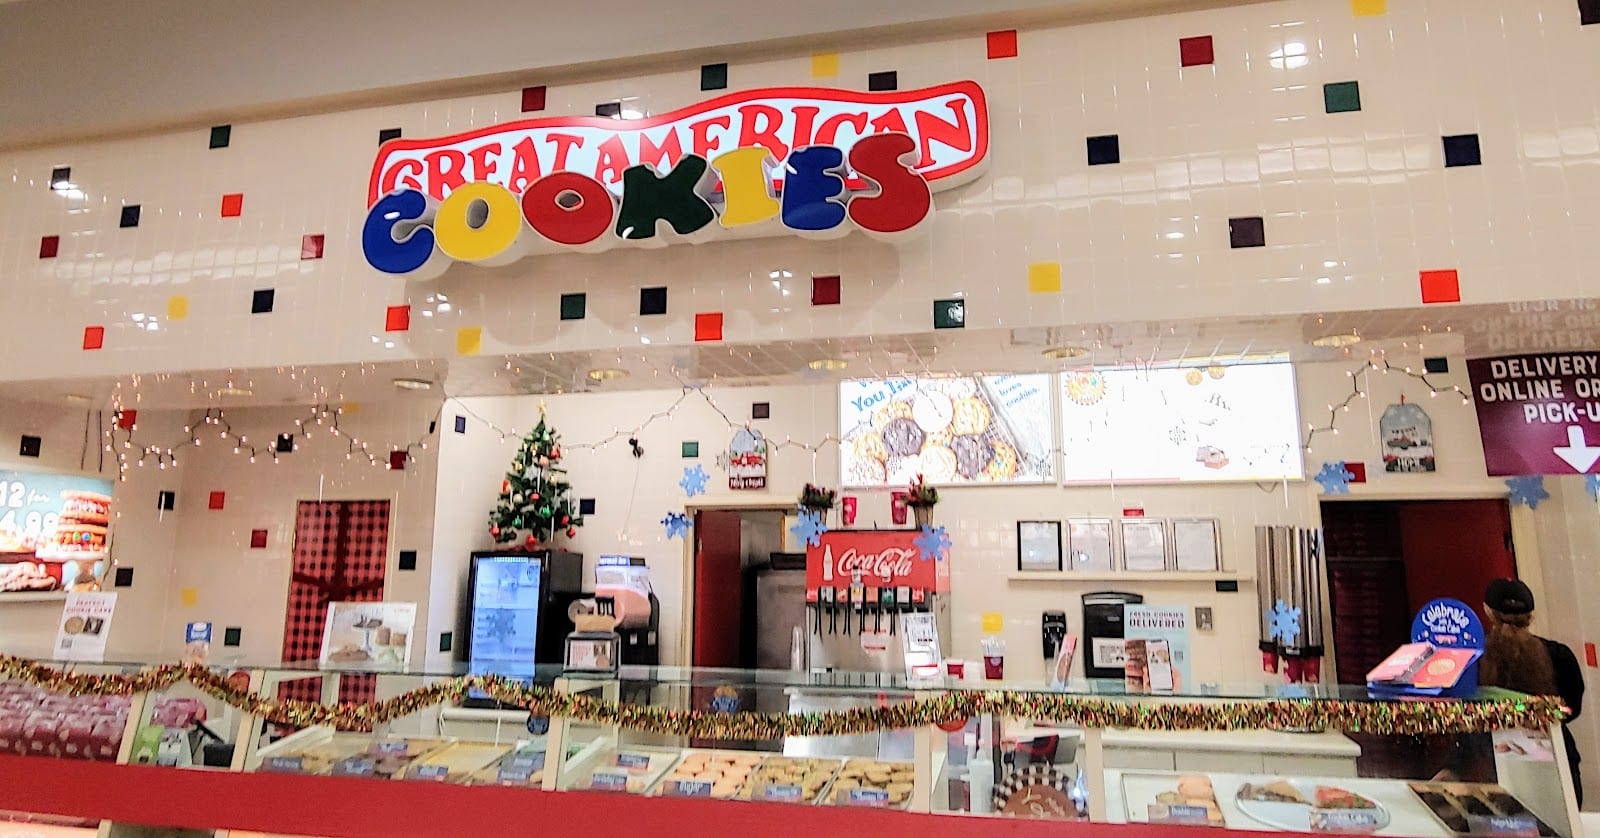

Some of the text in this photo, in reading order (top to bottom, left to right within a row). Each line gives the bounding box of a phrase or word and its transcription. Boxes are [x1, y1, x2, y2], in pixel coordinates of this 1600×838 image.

[382, 133, 584, 201] GREAT
[362, 131, 932, 274] COOKIES
[1490, 355, 1598, 380] DELIVERY
[850, 390, 886, 412] You
[1480, 378, 1565, 402] ONLINE
[1523, 401, 1600, 424] PICK-U
[1129, 619, 1185, 628] DELIVERED
[1422, 602, 1470, 628] Celebrate
